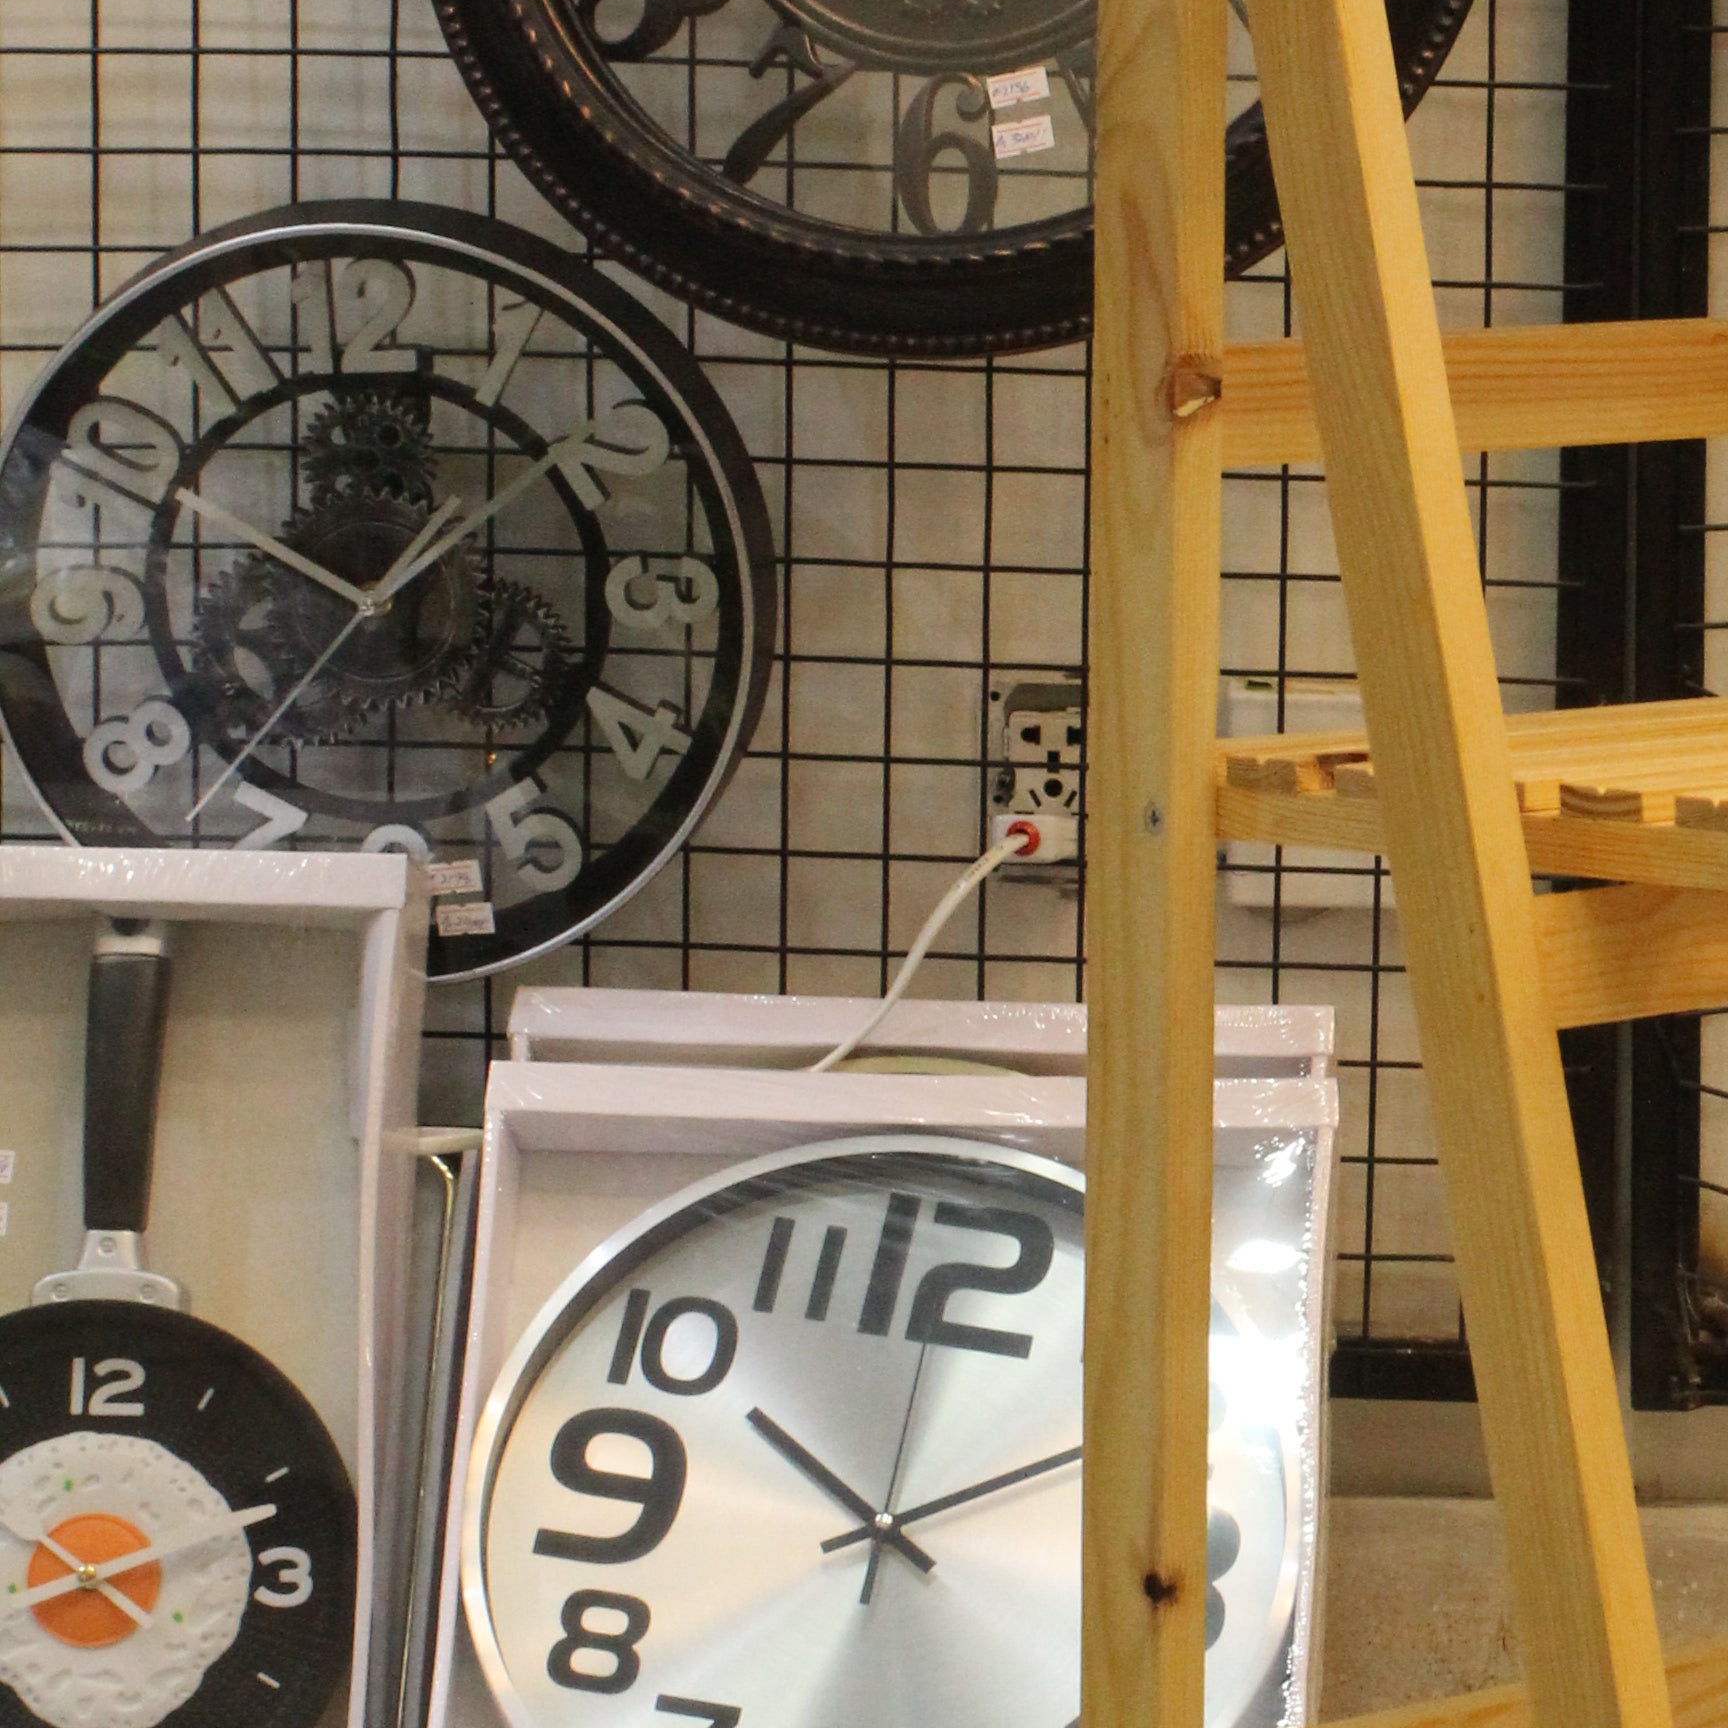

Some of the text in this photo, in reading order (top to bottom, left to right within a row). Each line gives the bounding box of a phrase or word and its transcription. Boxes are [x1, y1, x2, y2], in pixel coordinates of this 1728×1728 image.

[721, 20, 857, 187] 7
[896, 71, 998, 238] 6
[156, 287, 283, 415] 11
[292, 257, 418, 374] 12
[475, 293, 543, 407] 1
[56, 398, 182, 508] 10
[550, 398, 671, 511] 2
[30, 564, 146, 644] 9
[605, 554, 719, 630] 3
[83, 694, 190, 794] 8
[586, 685, 694, 781] 4
[486, 777, 583, 892] 5
[753, 1216, 847, 1323] 11
[857, 1192, 1057, 1360] 12
[70, 1357, 145, 1417] 12
[606, 1288, 740, 1397] 10
[532, 1407, 689, 1566] 9
[257, 1545, 313, 1609] 3
[545, 1588, 653, 1696] 8
